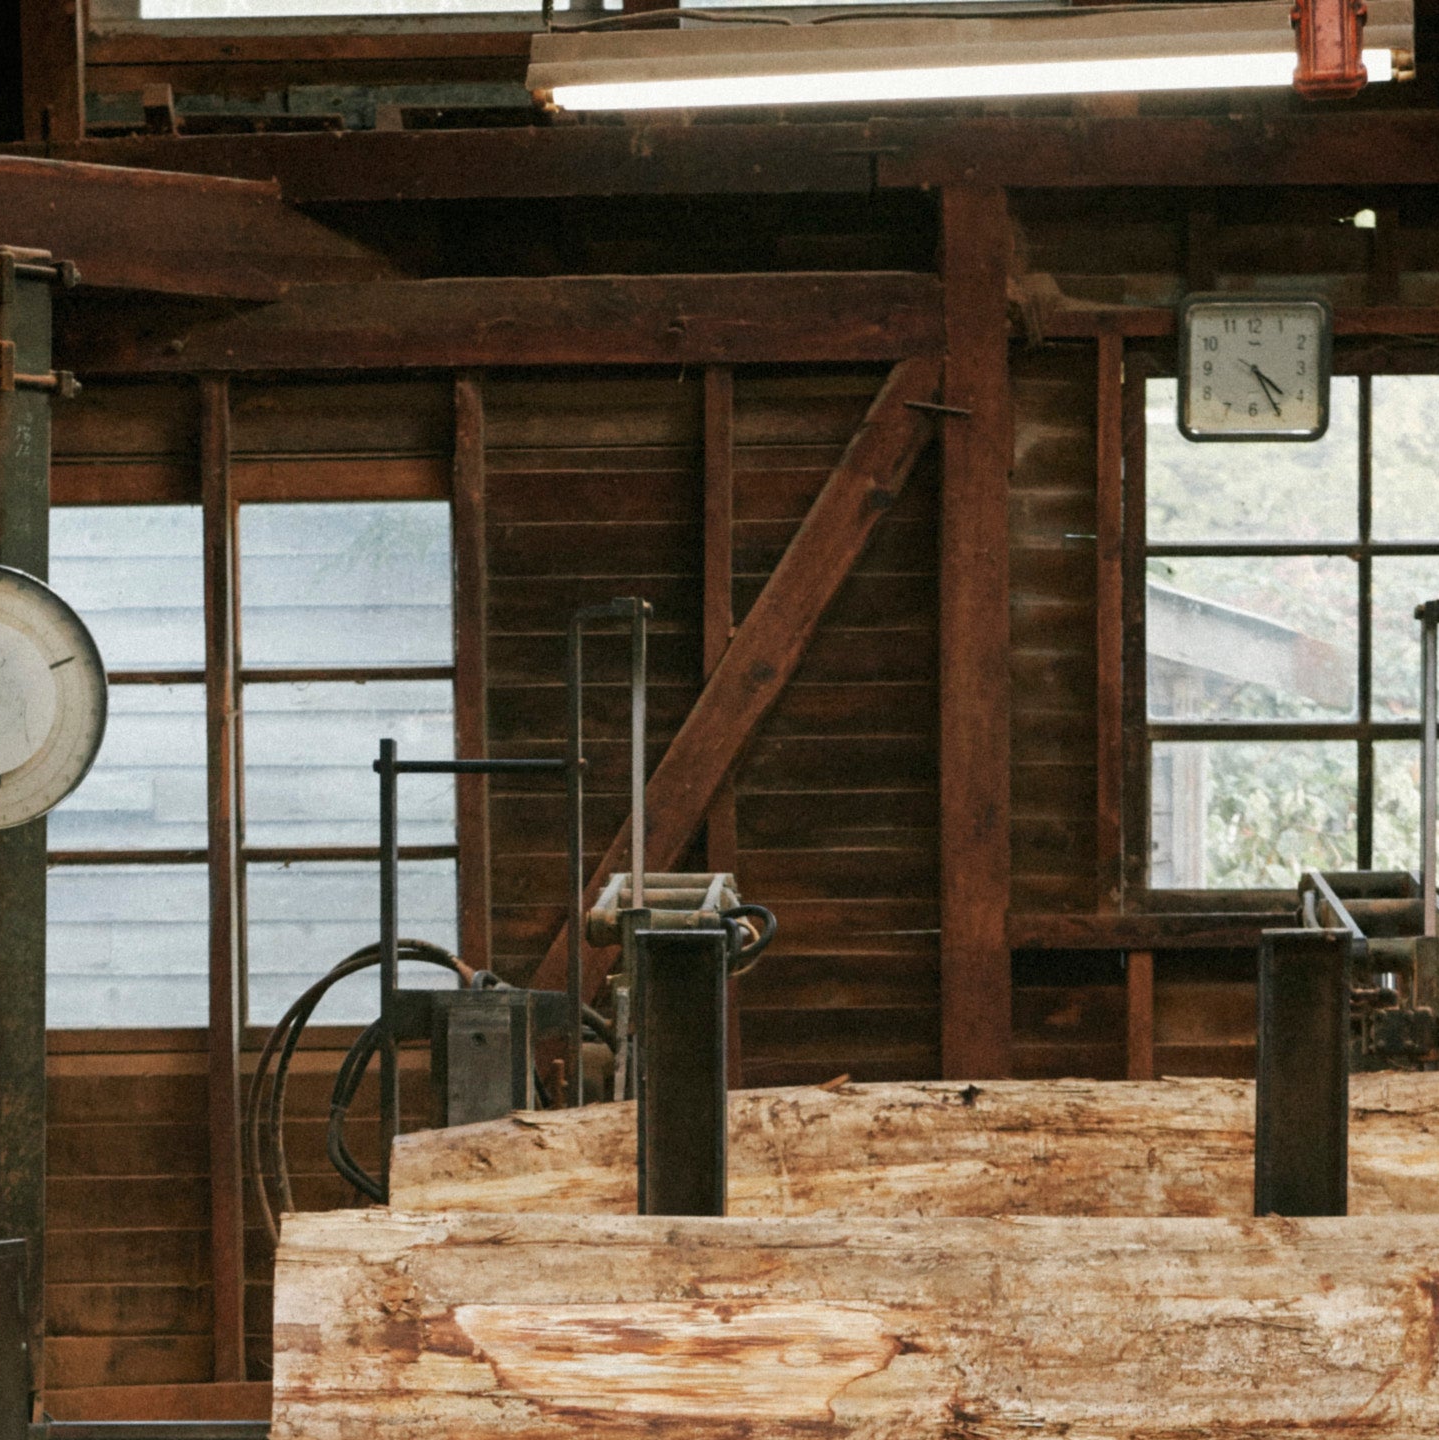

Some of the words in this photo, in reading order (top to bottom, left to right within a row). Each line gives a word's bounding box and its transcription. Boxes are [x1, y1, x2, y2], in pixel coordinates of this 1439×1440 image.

[1224, 319, 1236, 334] 11
[1248, 318, 1262, 334] 12
[1203, 336, 1218, 351] 10
[1297, 334, 1306, 350] 2
[1203, 361, 1213, 376] 9
[1297, 361, 1305, 376] 3
[1203, 386, 1212, 401] 8
[1248, 402, 1258, 417] 6
